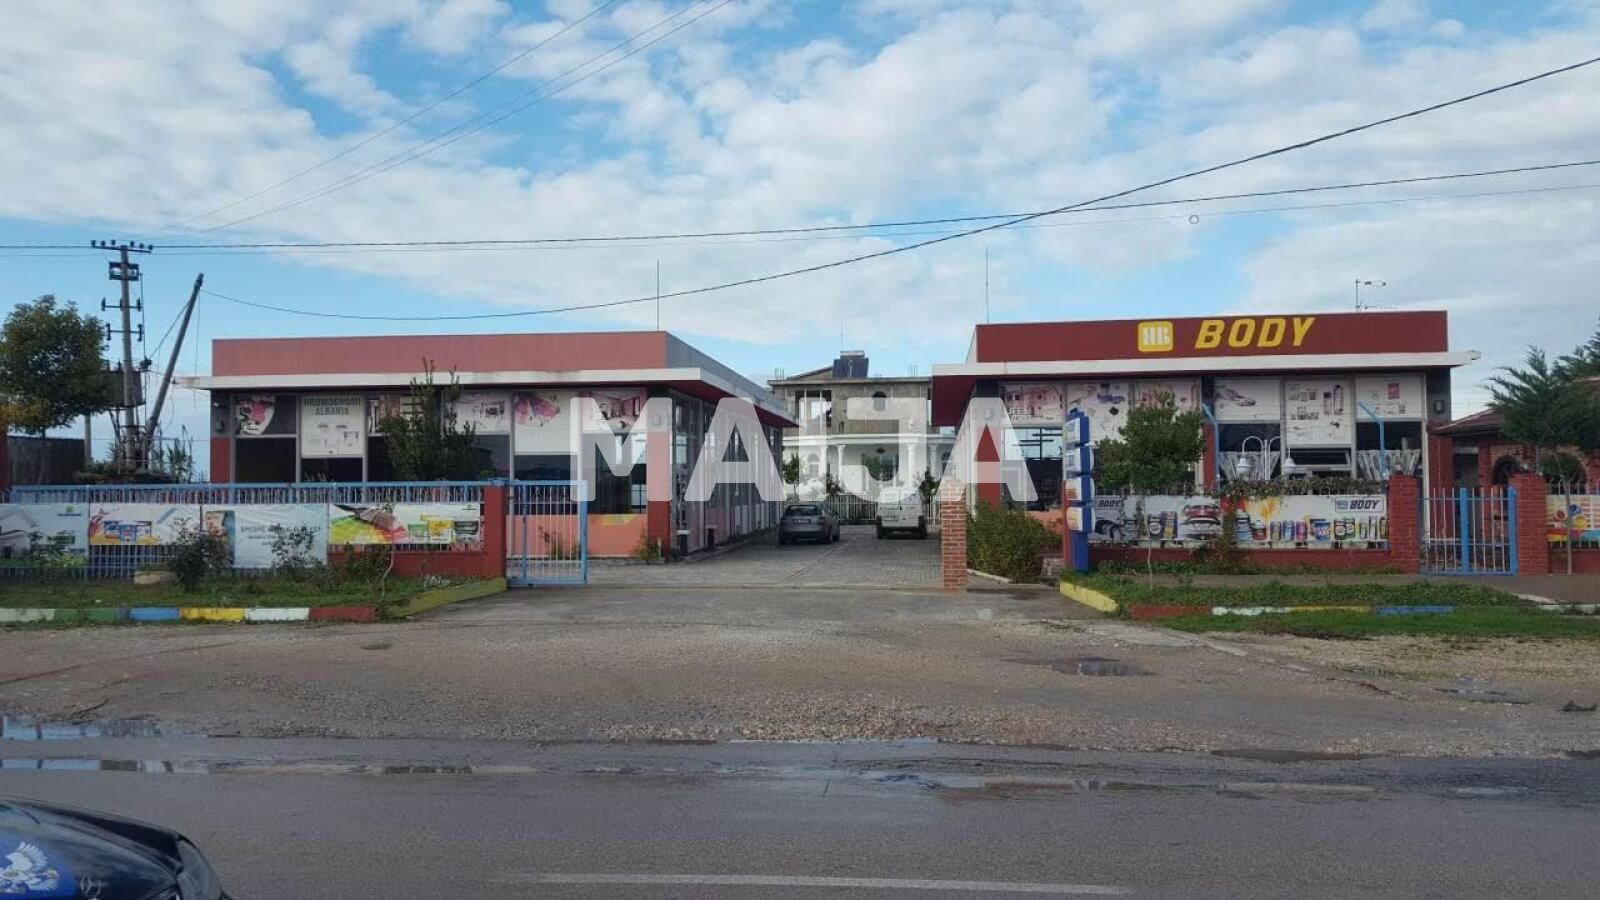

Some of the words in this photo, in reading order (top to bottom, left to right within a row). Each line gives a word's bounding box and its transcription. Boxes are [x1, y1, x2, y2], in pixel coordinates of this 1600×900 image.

[1195, 317, 1316, 349] BODY
[314, 407, 349, 416] ALBANIA
[1350, 499, 1380, 510] BODY
